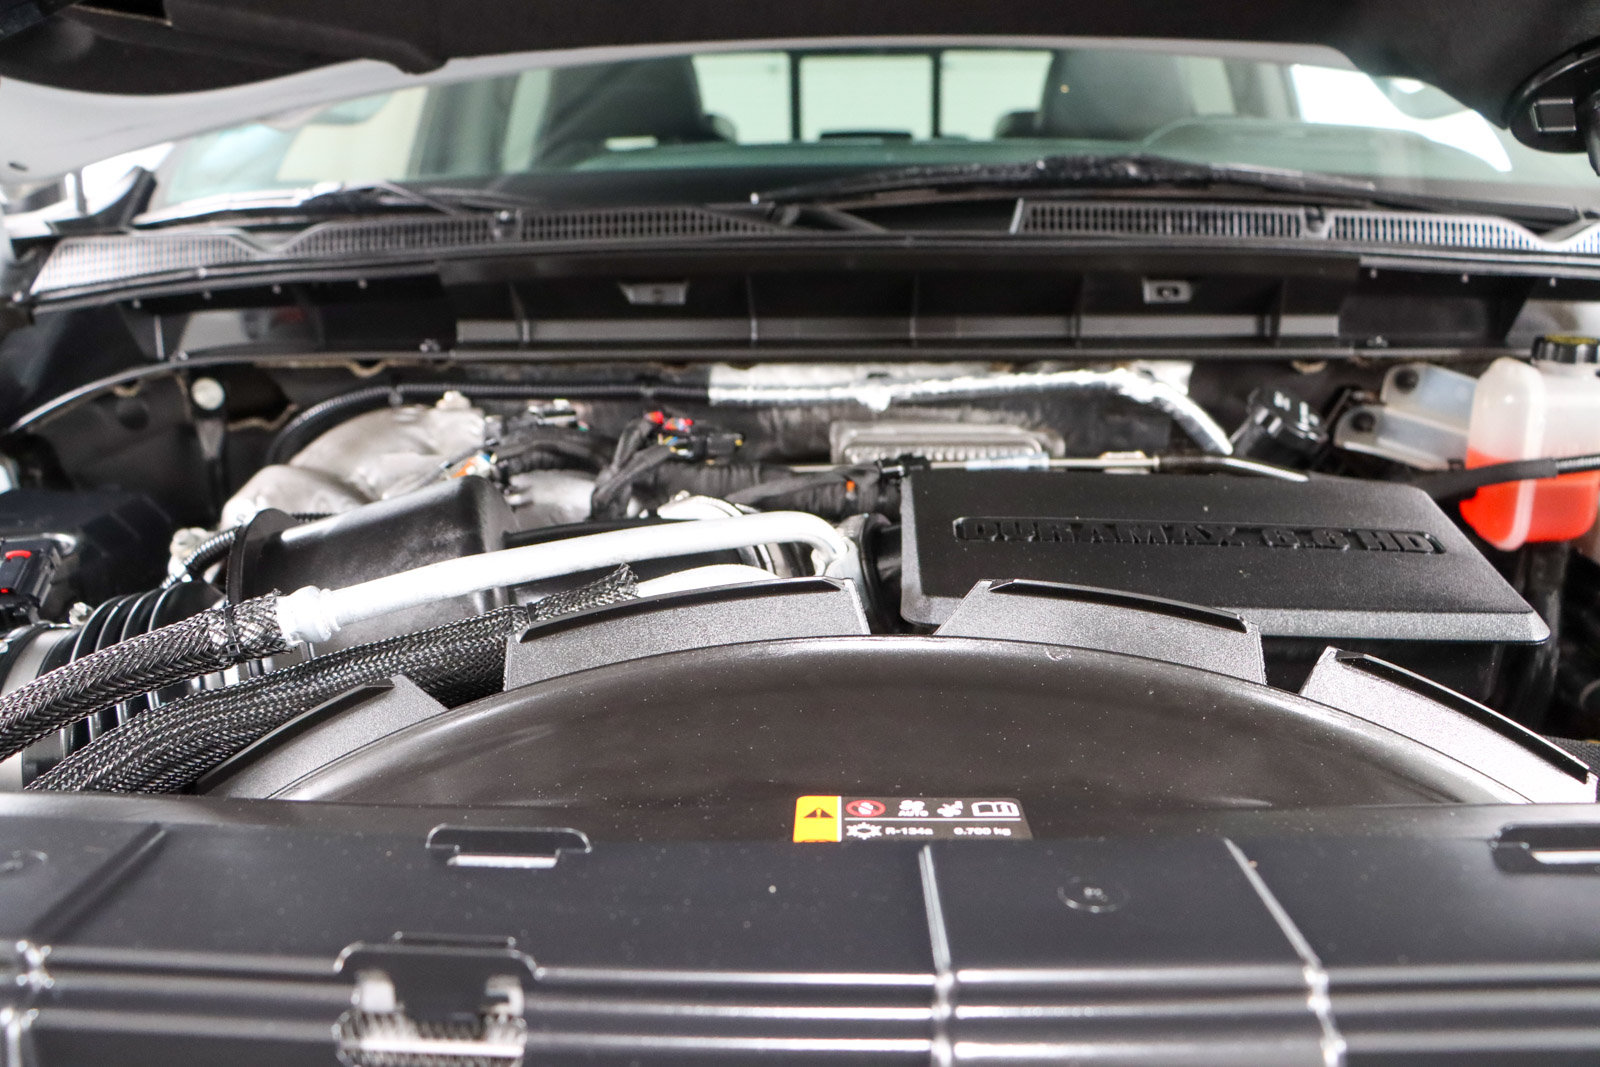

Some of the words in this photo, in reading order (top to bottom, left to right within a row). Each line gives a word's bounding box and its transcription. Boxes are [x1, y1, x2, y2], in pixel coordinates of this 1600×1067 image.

[964, 520, 1243, 547] DURAMAX
[1262, 527, 1350, 551] 6.6
[1356, 530, 1435, 553] HD
[993, 827, 1011, 837] kg
